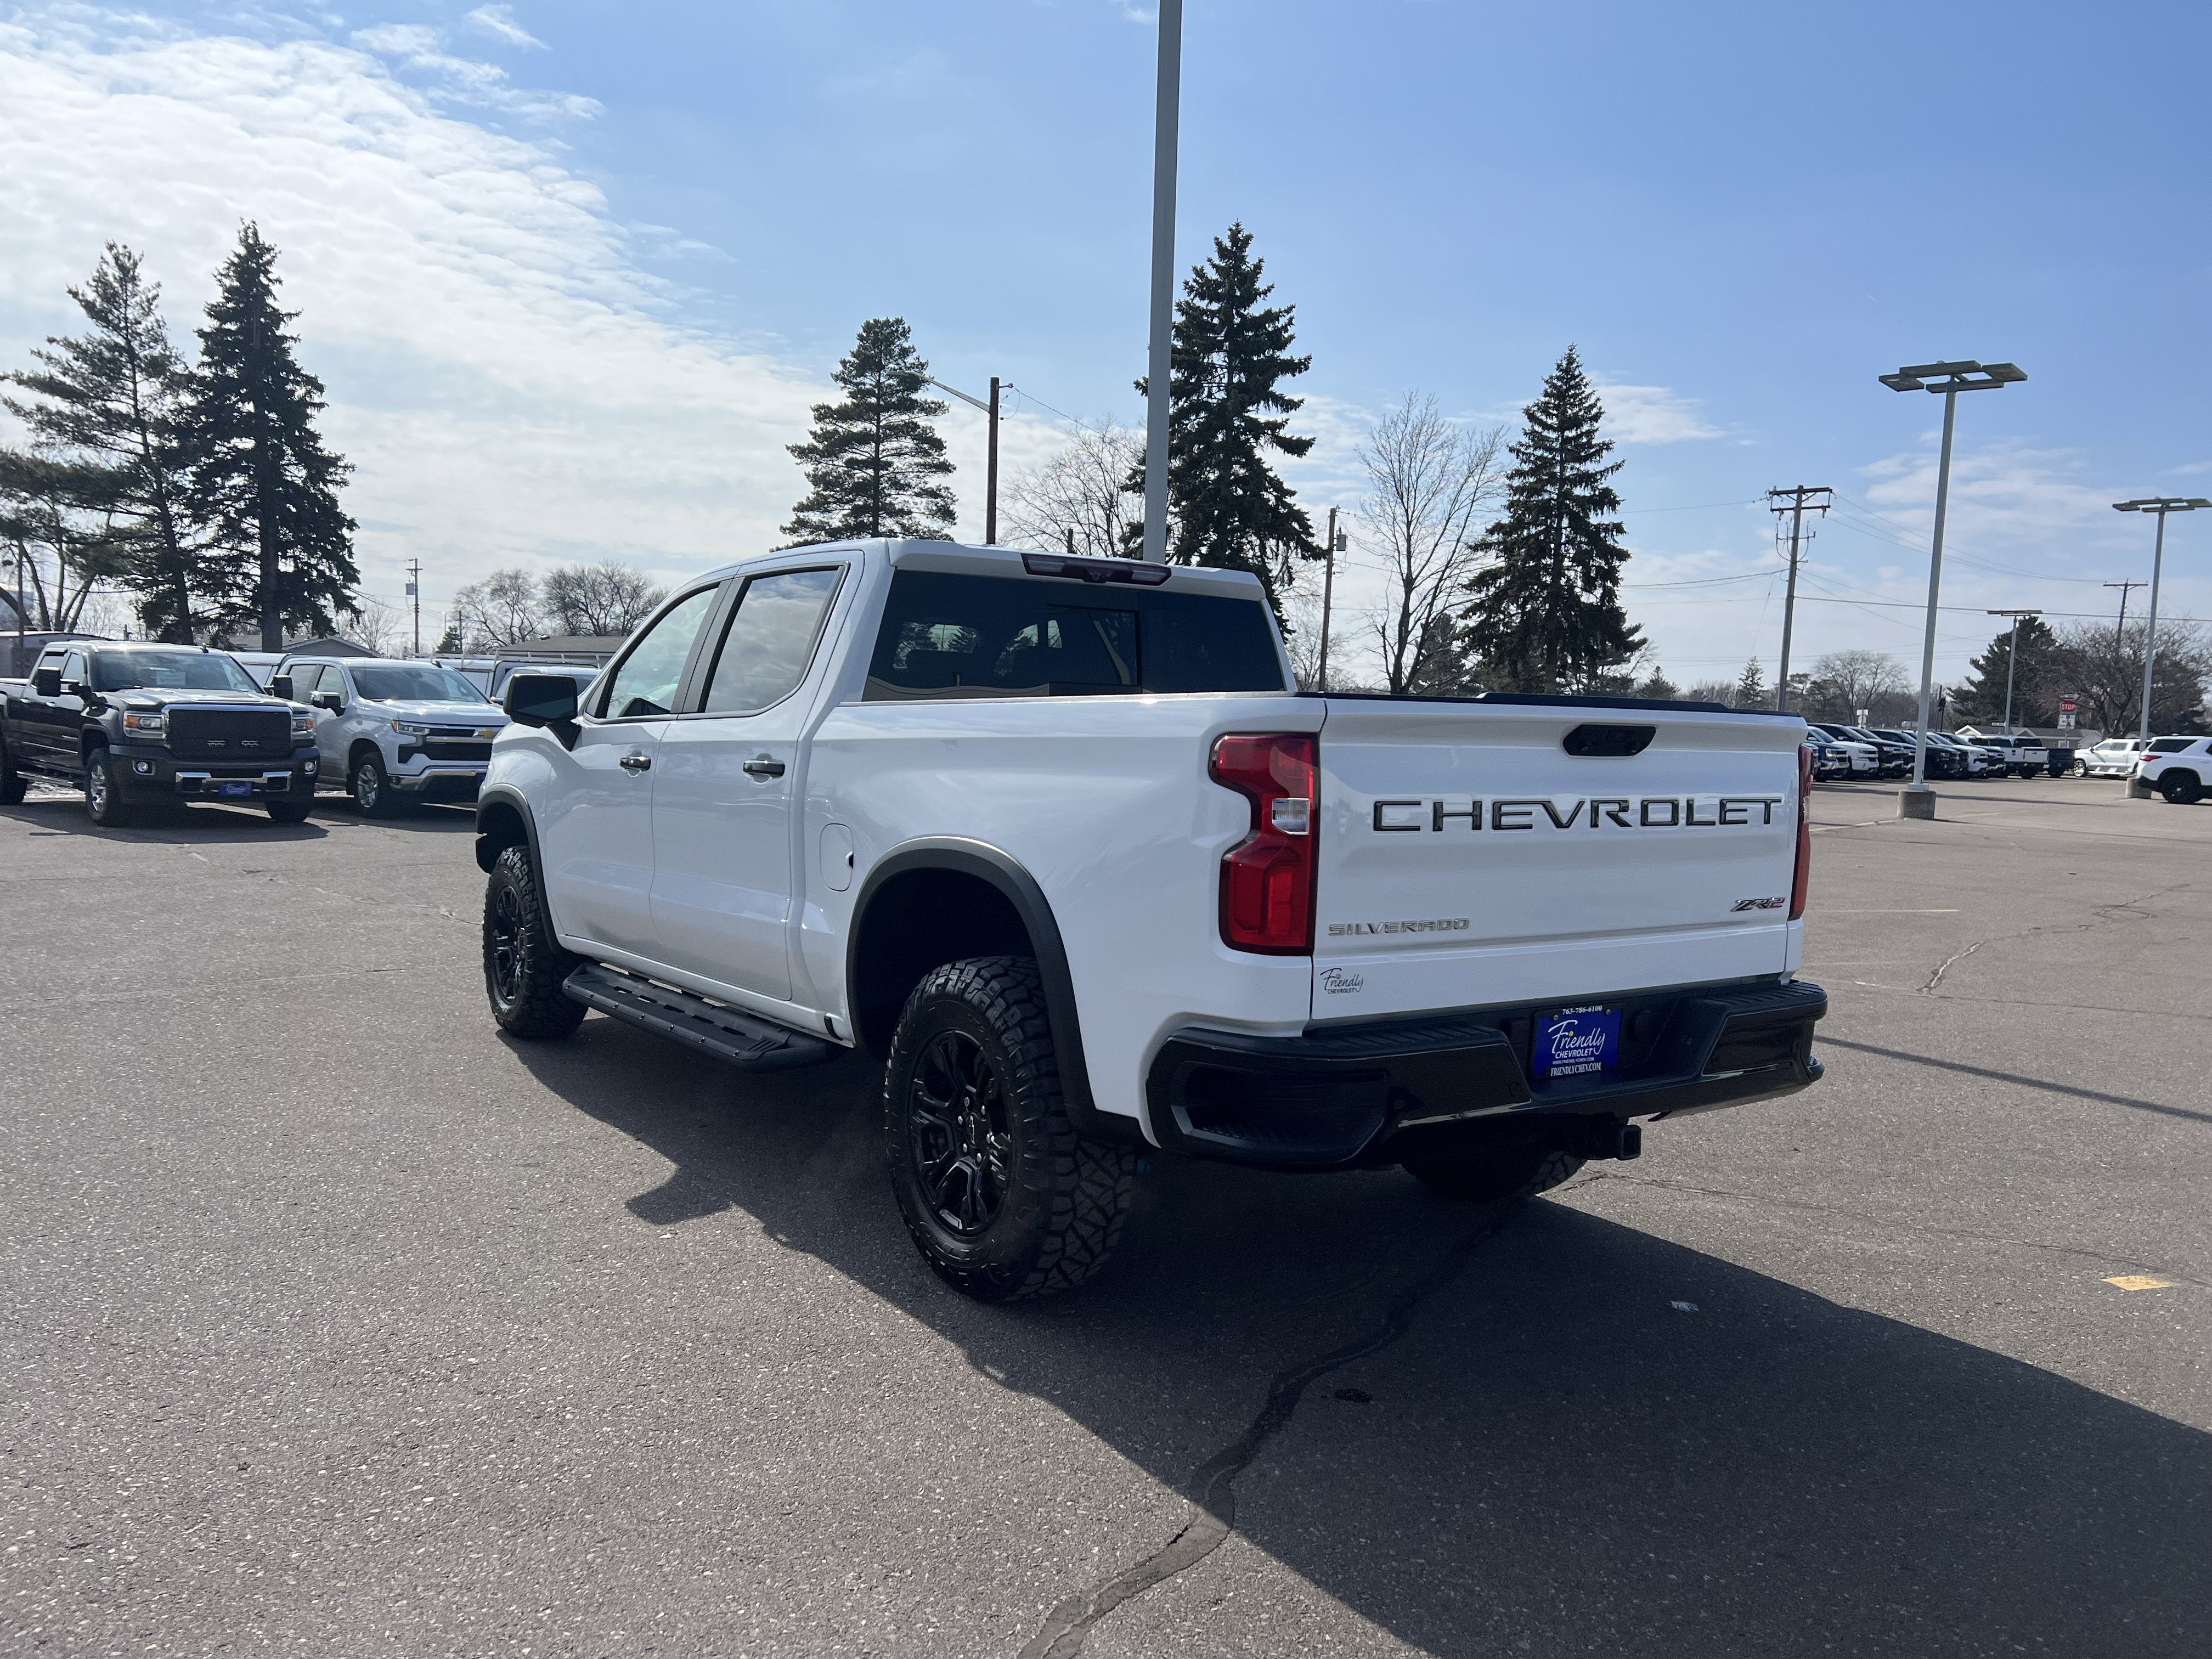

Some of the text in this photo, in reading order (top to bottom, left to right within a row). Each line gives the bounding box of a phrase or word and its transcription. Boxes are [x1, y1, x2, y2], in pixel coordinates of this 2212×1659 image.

[1373, 799, 1782, 832] CHEVROLET
[1730, 897, 1786, 912] ZR2
[1328, 918, 1470, 936] SILVERADO
[1320, 968, 1364, 992] Friendly
[1562, 1005, 1602, 1015] 763-786-6100
[1548, 1019, 1605, 1055] Friendly
[1555, 1048, 1593, 1059] CHEVROLET
[1550, 1062, 1601, 1076] FRIENDLYCHEV.COM
